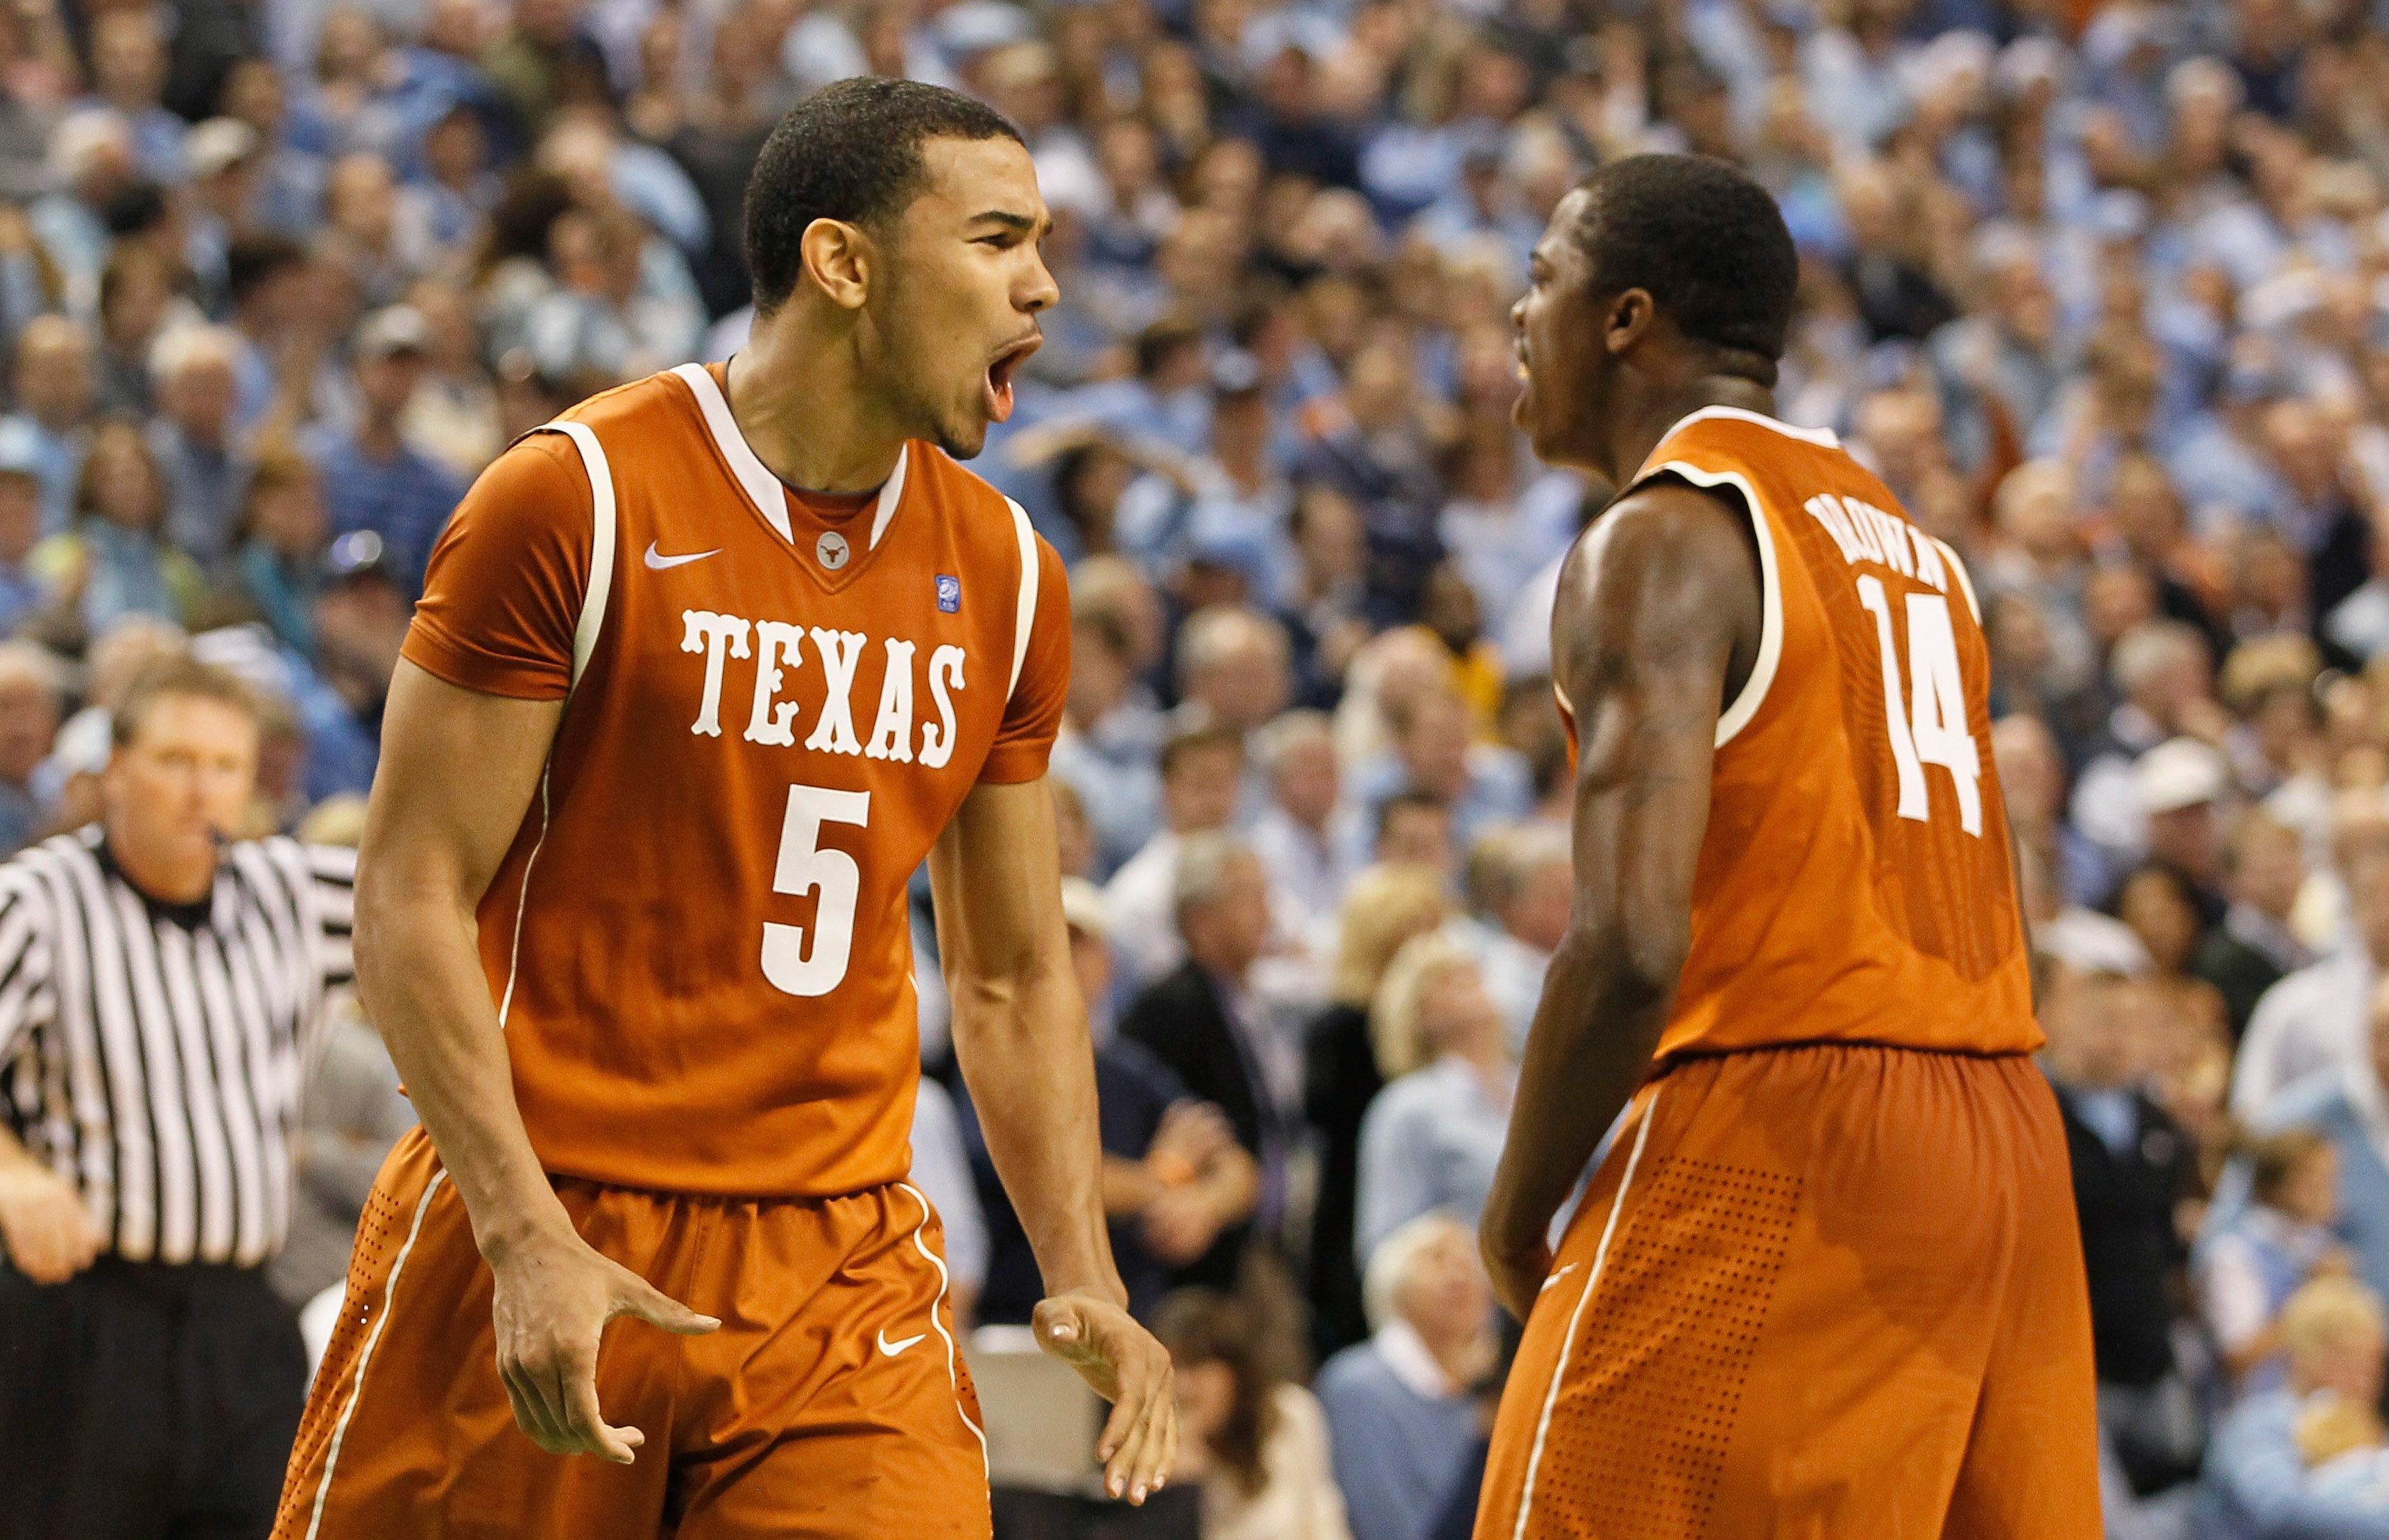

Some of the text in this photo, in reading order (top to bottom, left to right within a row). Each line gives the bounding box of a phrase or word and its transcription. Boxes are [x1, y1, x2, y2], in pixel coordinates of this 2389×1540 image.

[1804, 493, 1949, 594] BROWN
[680, 609, 966, 769] TEXAS
[1856, 573, 1983, 839] 14
[760, 783, 871, 997] 5
